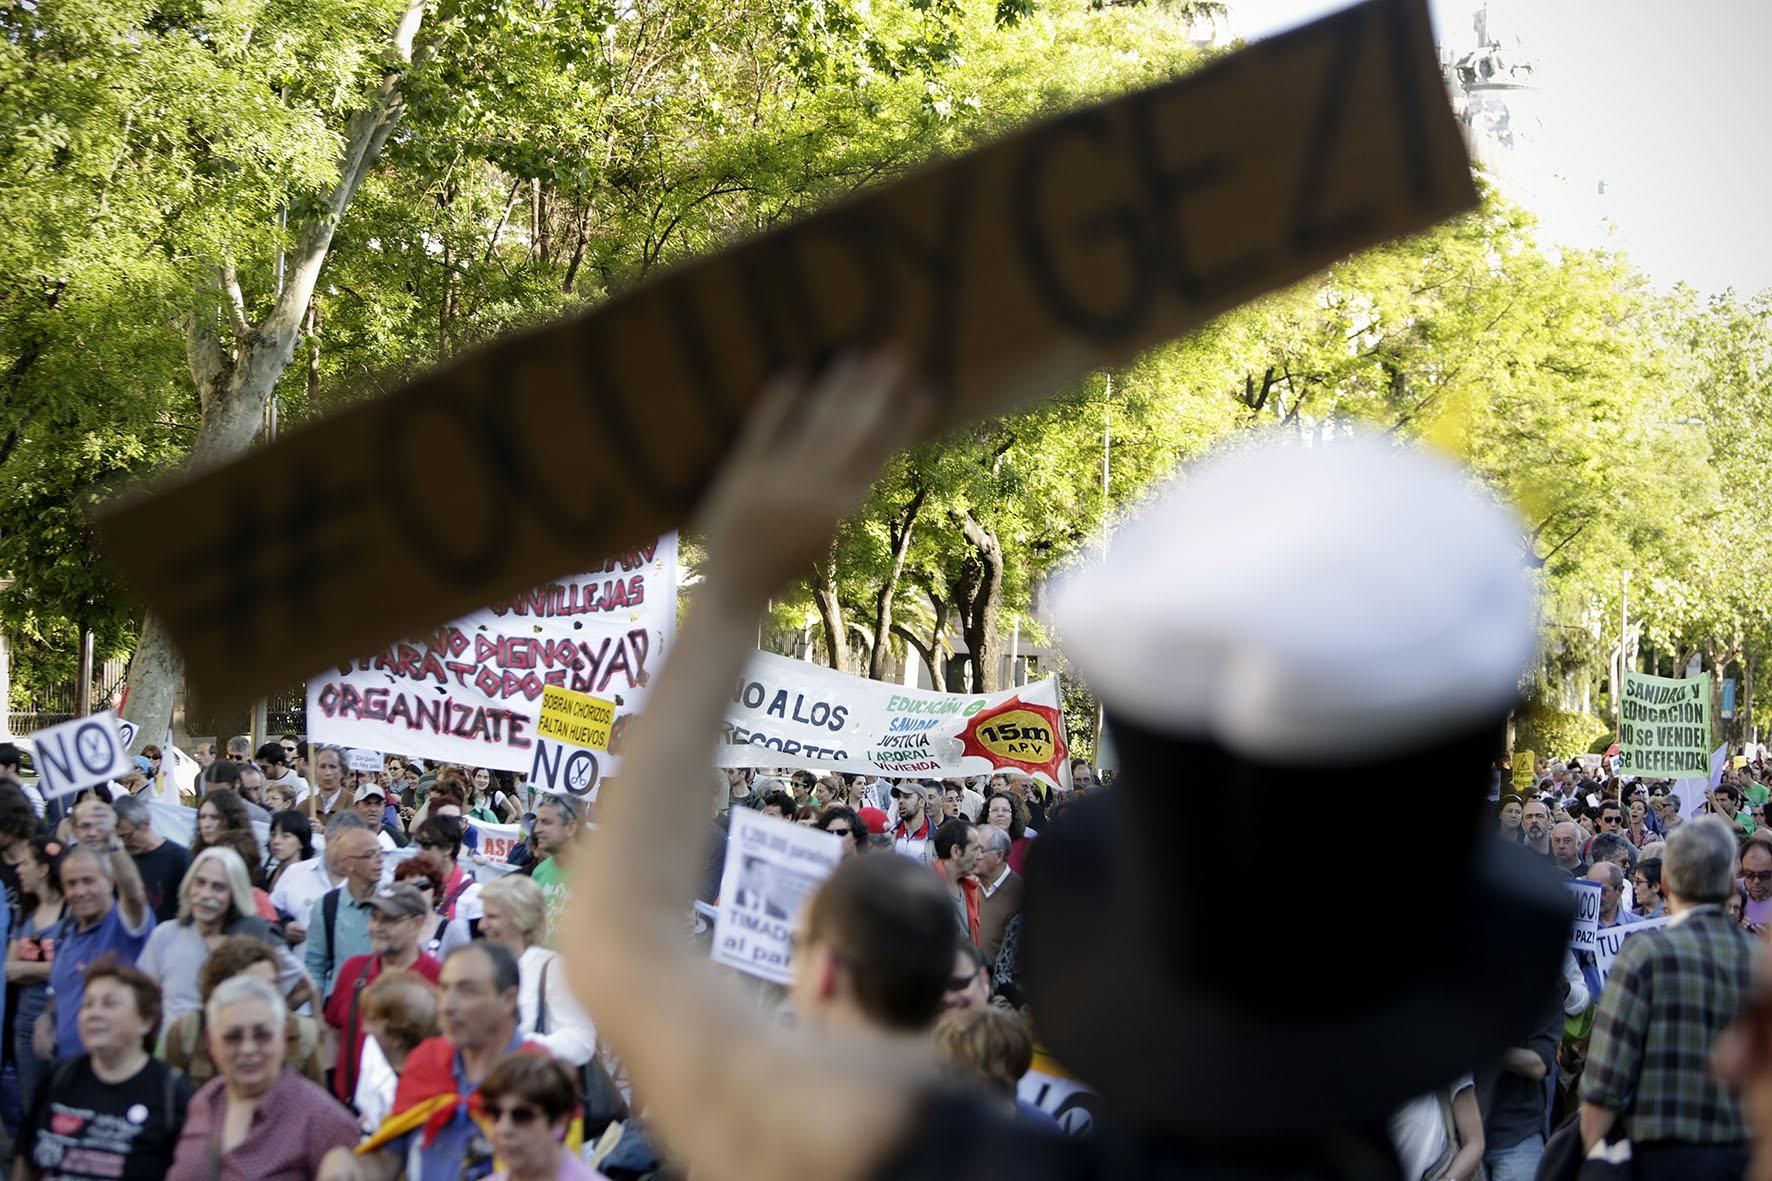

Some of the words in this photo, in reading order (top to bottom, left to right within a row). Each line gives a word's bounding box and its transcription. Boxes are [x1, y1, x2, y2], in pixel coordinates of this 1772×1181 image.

[1012, 0, 1437, 348] GEZI
[475, 632, 579, 671] DIGNO
[1625, 678, 1687, 705] SANIDAD
[542, 693, 573, 716] SOBRAN
[572, 701, 612, 725] CHORIZOS.
[766, 689, 789, 719] A
[791, 693, 850, 732] LOS
[1621, 699, 1704, 724] EDUCACIÓN
[538, 715, 569, 738] FALTAN
[568, 723, 607, 748] HUEVOS.
[876, 732, 931, 749] JUSTICIA
[1635, 728, 1654, 747] se
[35, 721, 115, 791] NO
[530, 738, 599, 797] NO
[866, 748, 935, 763] LABORAL
[1596, 934, 1620, 958] TU
